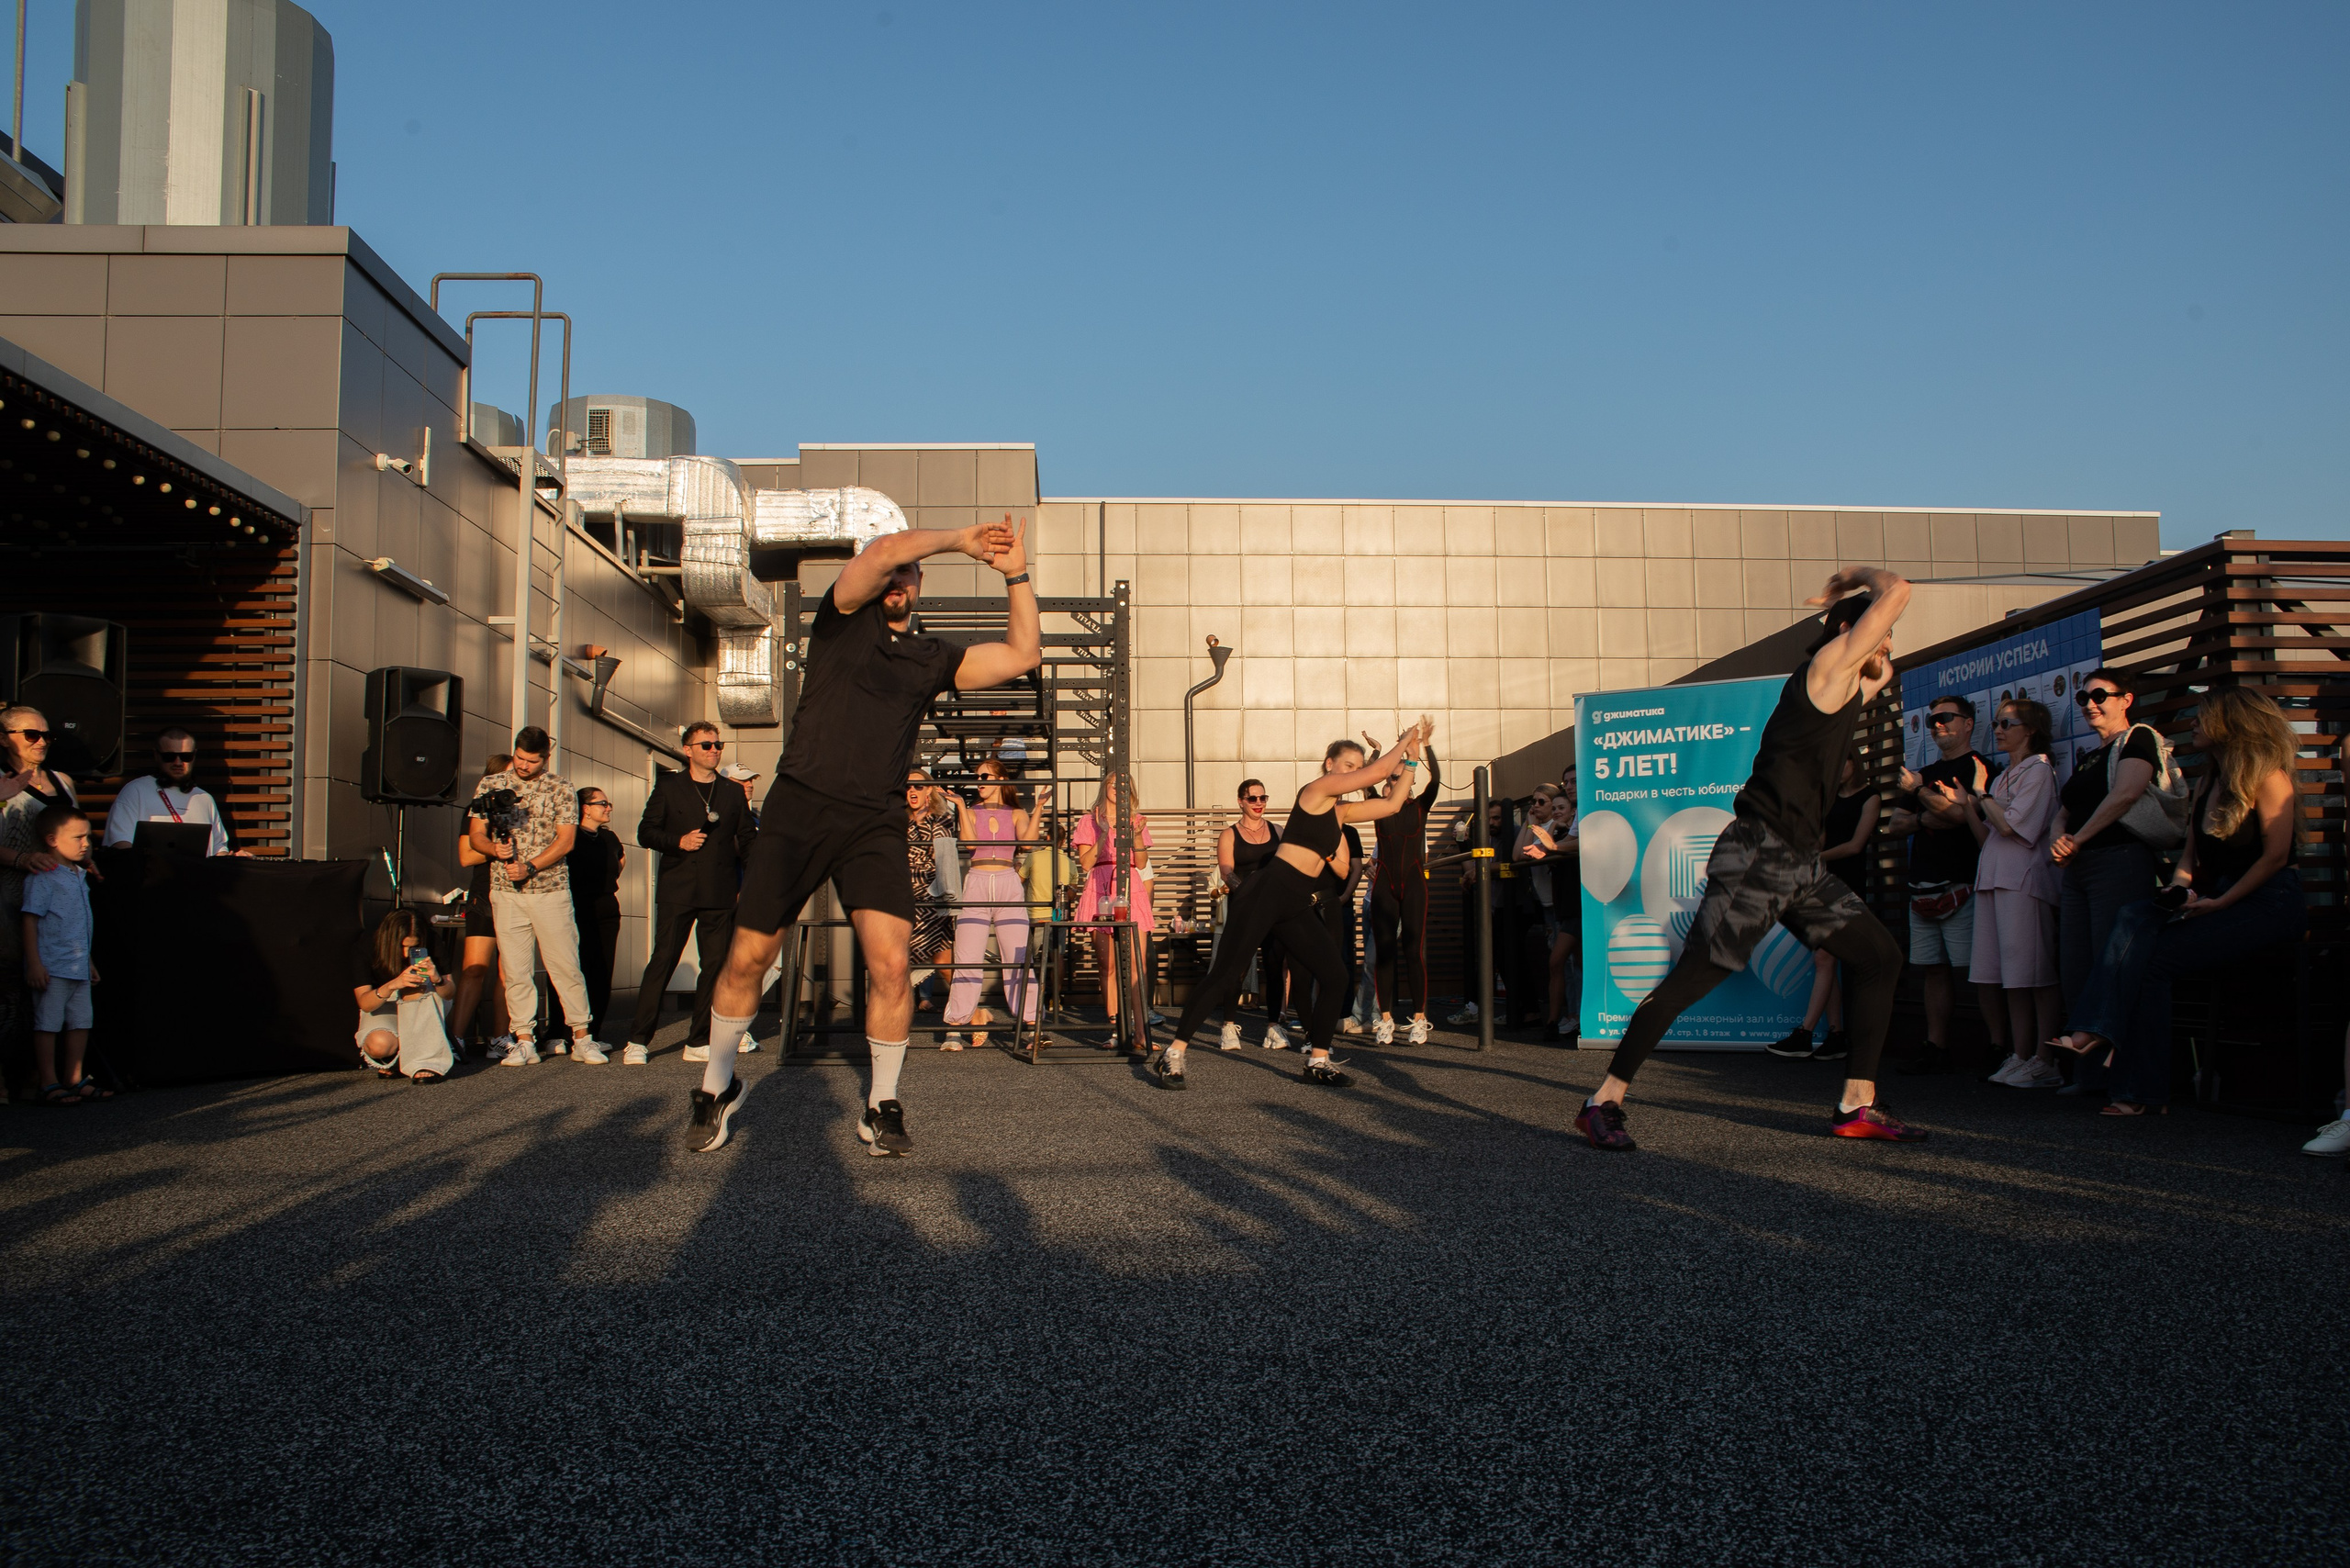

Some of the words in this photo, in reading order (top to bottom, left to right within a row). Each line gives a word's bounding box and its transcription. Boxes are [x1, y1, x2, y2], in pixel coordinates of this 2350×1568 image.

[1938, 655, 1995, 689] ИСТОРИИ
[1996, 639, 2049, 671] УСПЕХА
[1594, 723, 1735, 750] «ДЖИМАТИКЕ»
[1595, 757, 1610, 779] 5
[1616, 753, 1678, 778] ЛЕТ!
[1595, 789, 1648, 801] Подарки
[1651, 789, 1658, 799] в
[1662, 786, 1695, 798] честь
[1676, 1014, 1744, 1025] ренажерный
[1746, 1015, 1764, 1024] зал
[1766, 1015, 1774, 1024] и
[1608, 1028, 1620, 1036] ул.
[1676, 1029, 1694, 1037] стр.
